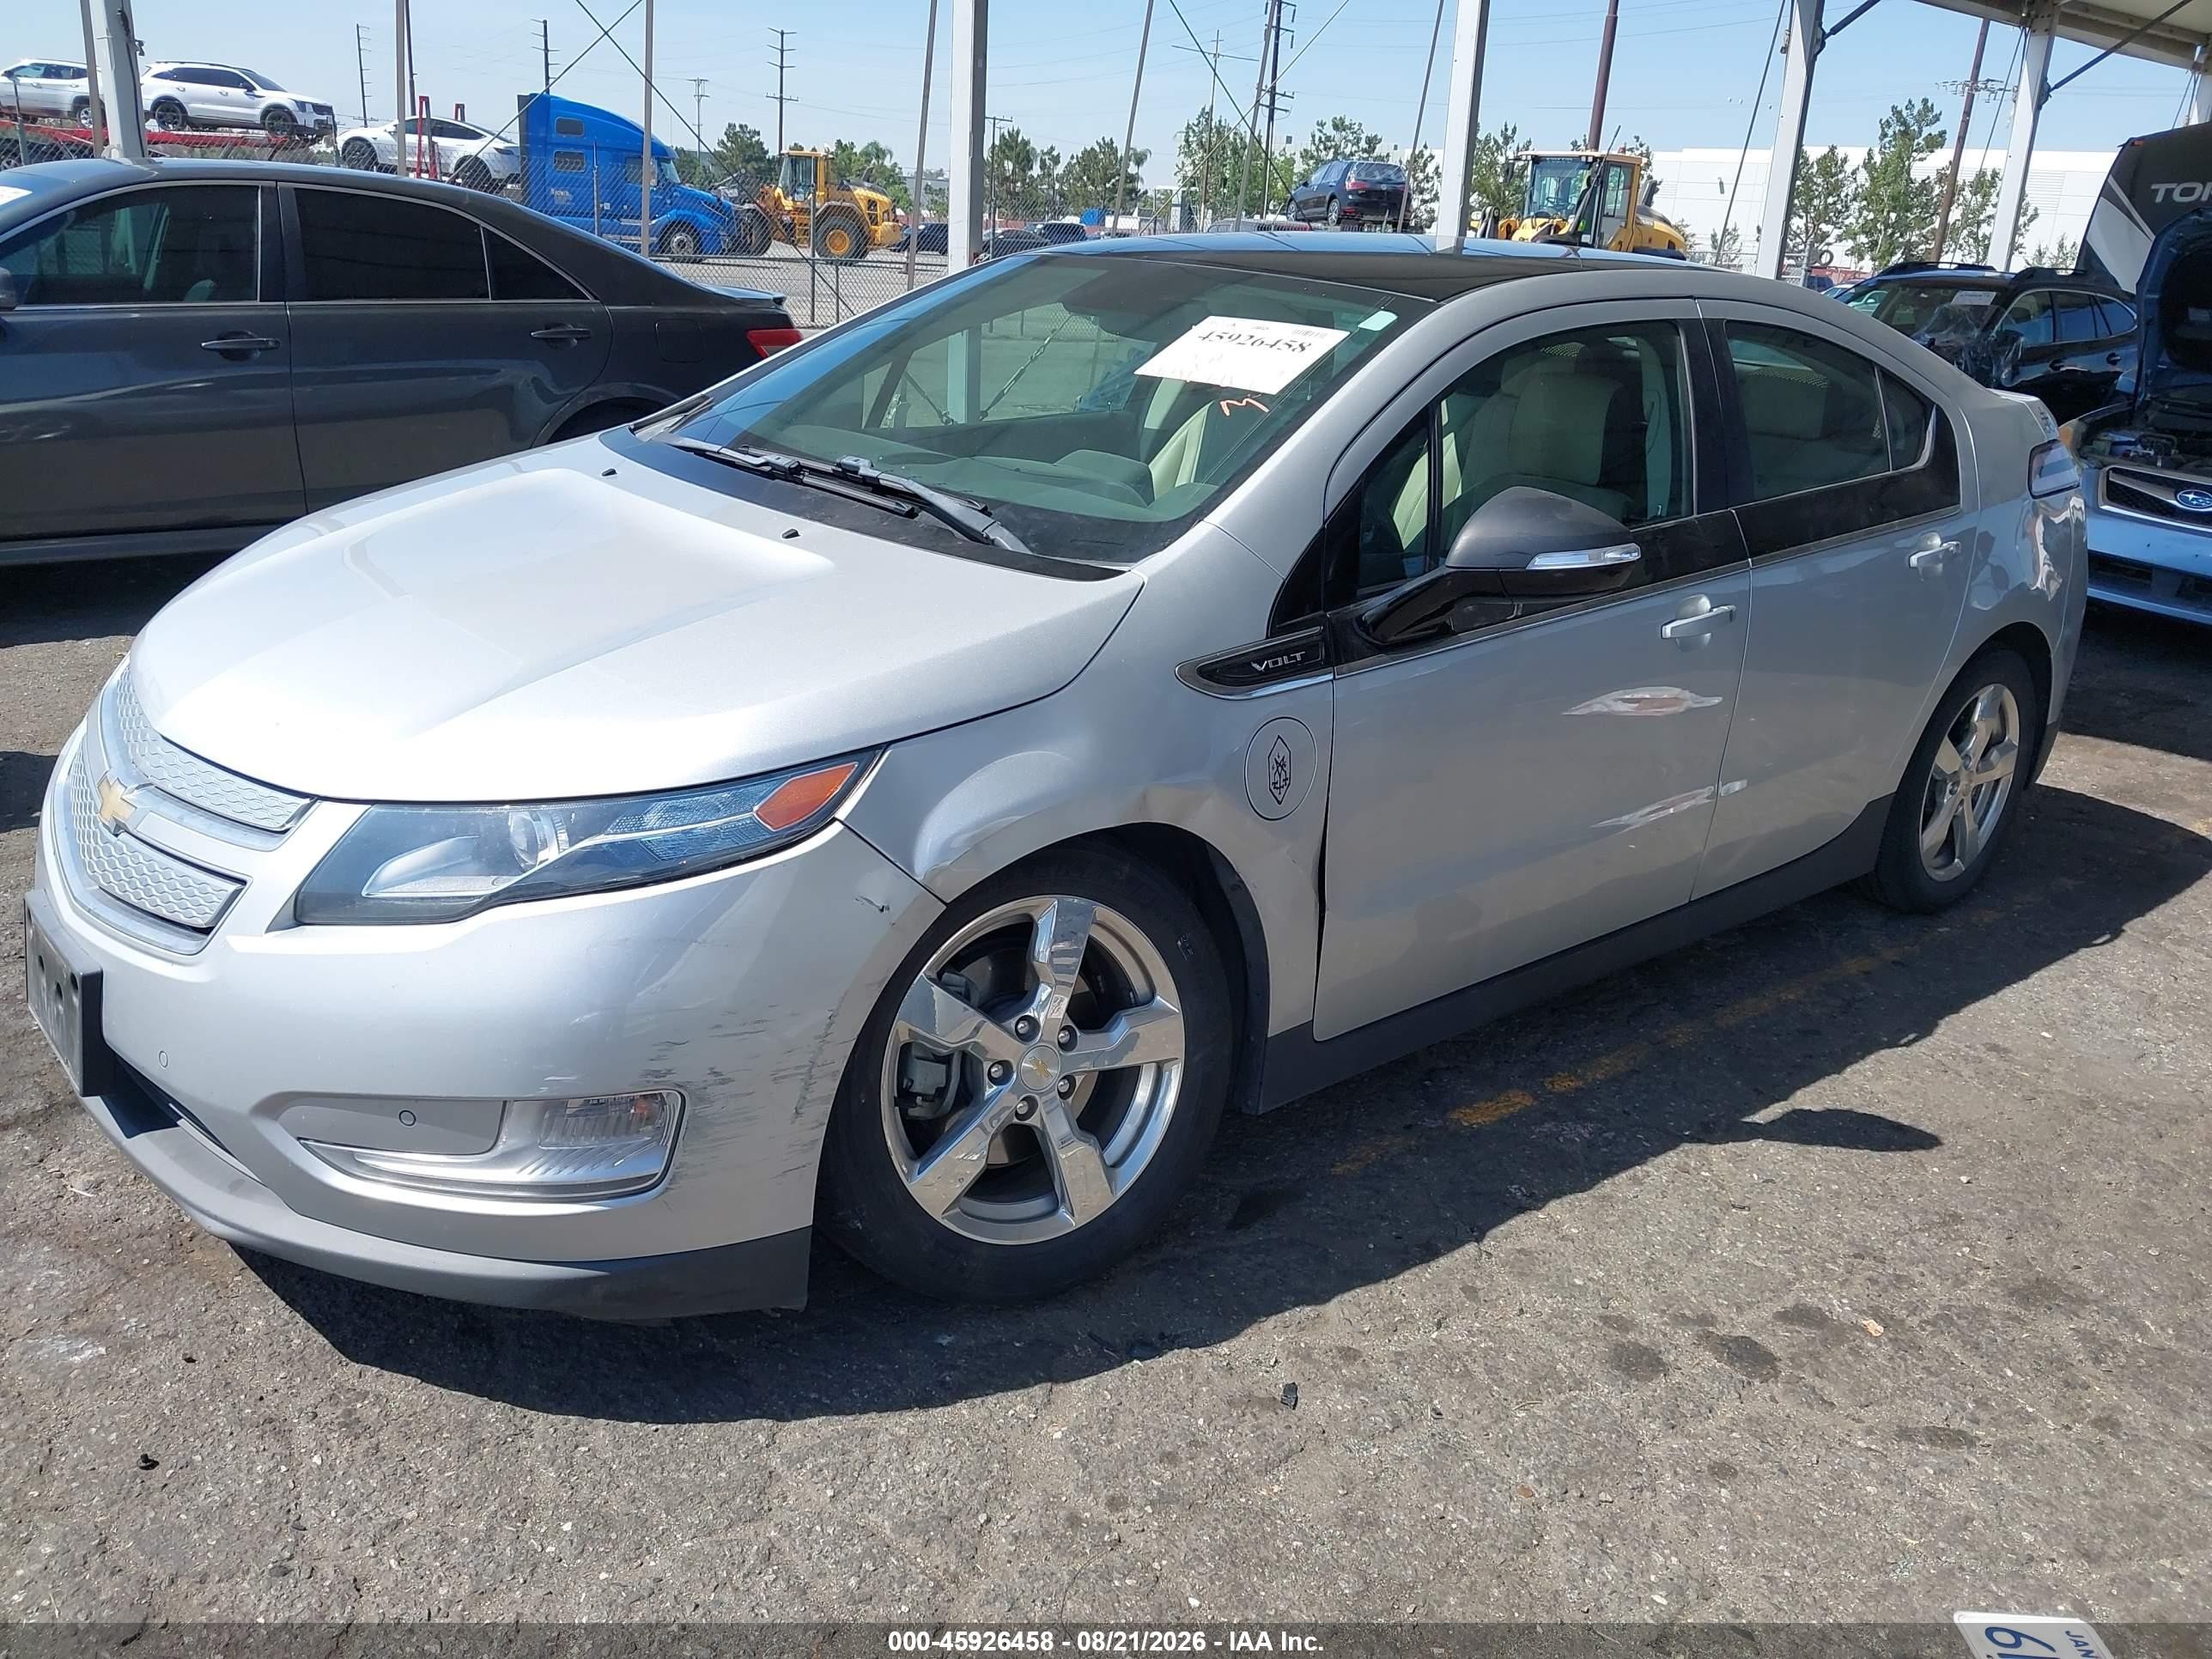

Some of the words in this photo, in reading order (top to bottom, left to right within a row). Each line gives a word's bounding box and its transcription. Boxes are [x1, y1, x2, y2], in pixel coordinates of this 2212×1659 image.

[1198, 331, 1312, 353] 45926458
[1250, 651, 1306, 672] VOLT
[2064, 1630, 2100, 1659] JAN
